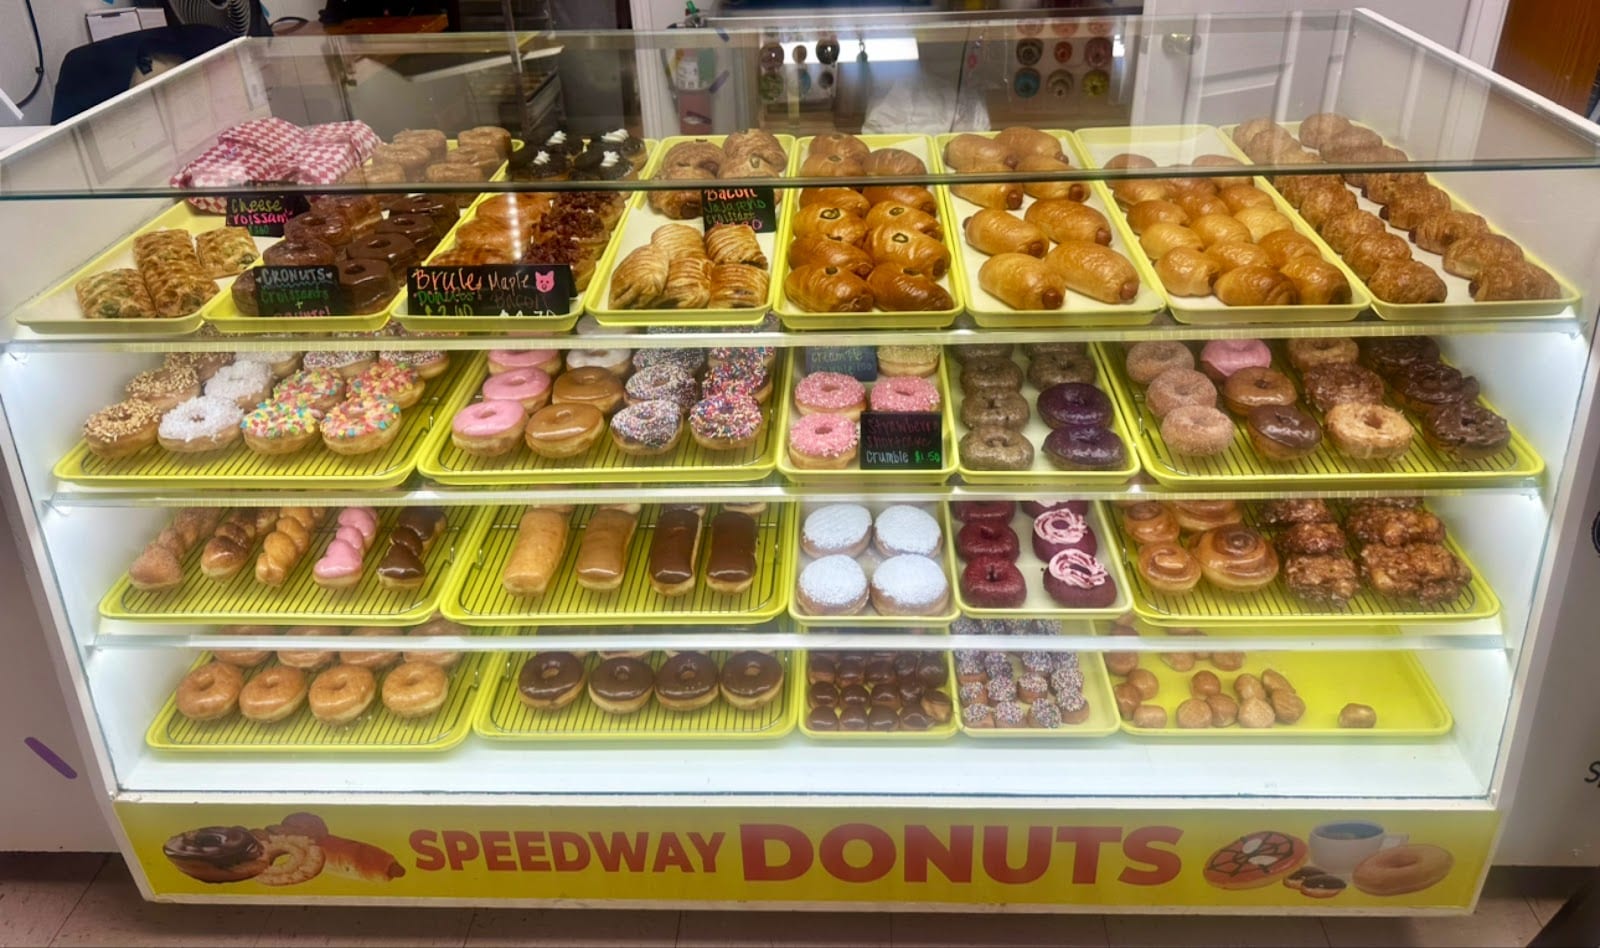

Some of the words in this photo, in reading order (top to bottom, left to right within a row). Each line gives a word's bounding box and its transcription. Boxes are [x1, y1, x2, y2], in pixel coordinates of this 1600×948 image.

[231, 198, 282, 213] Cheese
[262, 267, 326, 286] CRONUTS
[488, 270, 529, 296] Maple
[409, 829, 725, 873] SPEEDWAY
[739, 823, 1184, 886] DONUTS
